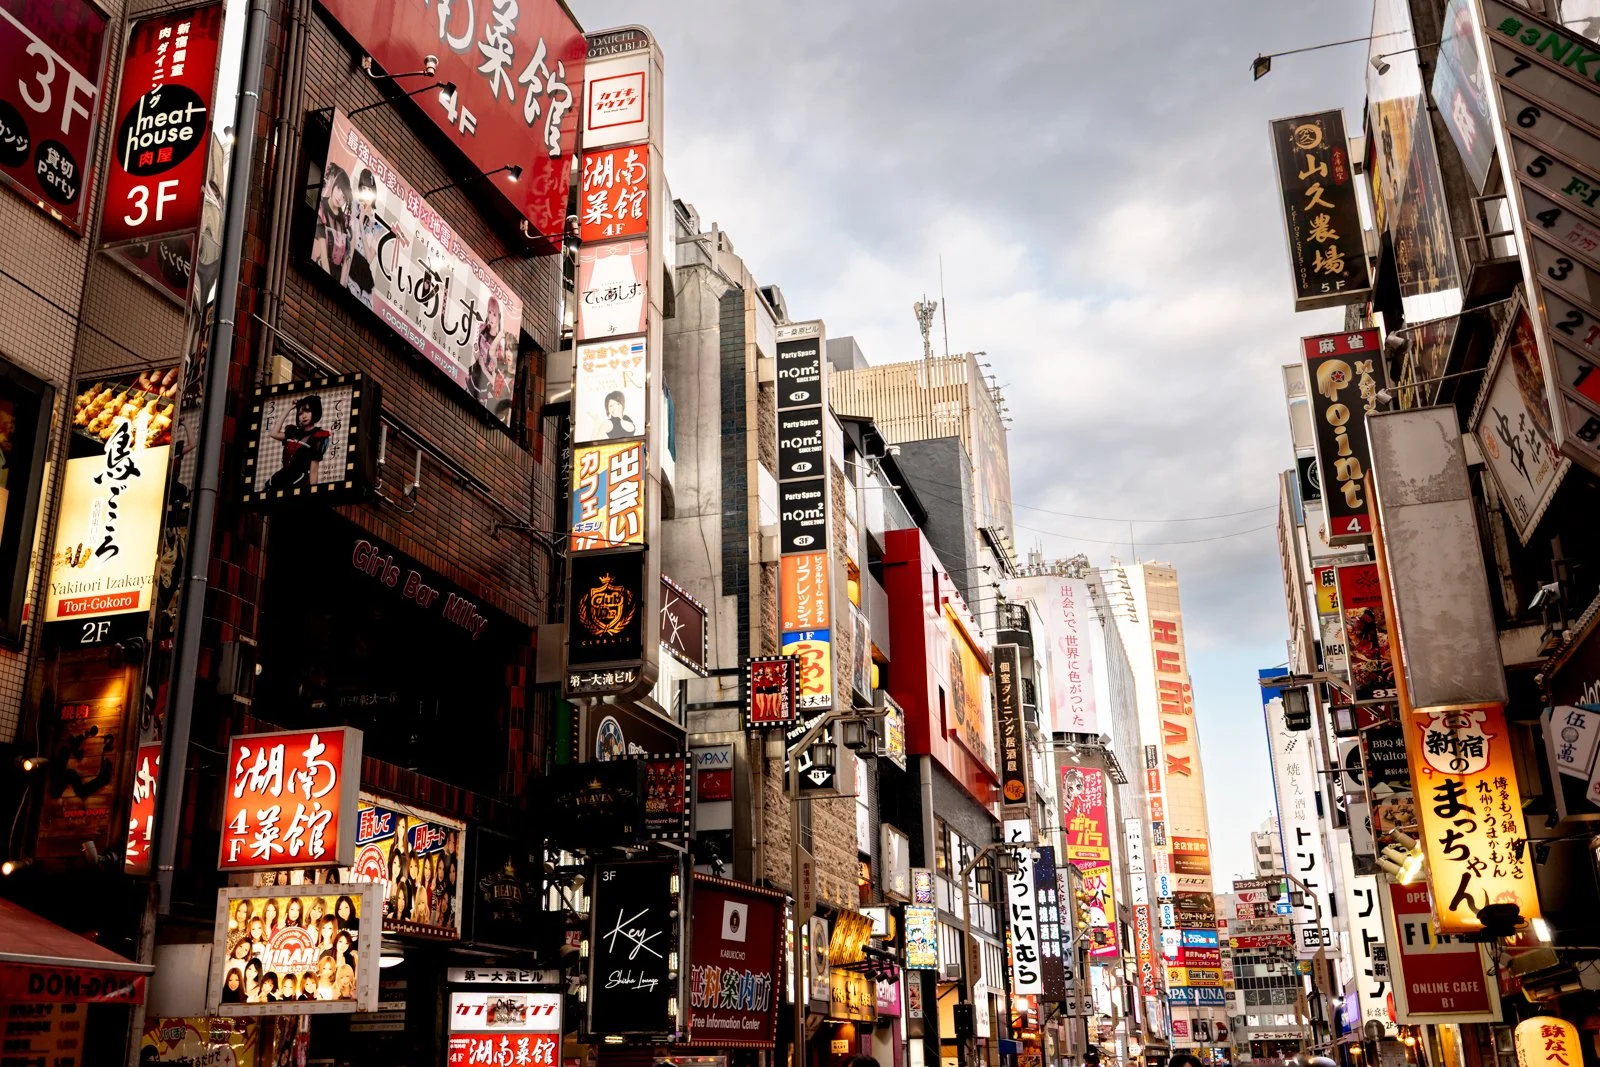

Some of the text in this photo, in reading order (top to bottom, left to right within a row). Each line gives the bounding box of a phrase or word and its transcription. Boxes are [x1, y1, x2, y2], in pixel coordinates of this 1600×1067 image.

[170, 22, 190, 77] 新宿個室
[1505, 56, 1532, 78] 7
[18, 42, 98, 136] 3F
[136, 95, 207, 136] meat
[437, 87, 478, 137] 4F
[1516, 106, 1541, 129] 6
[123, 126, 193, 172] house
[138, 148, 173, 166] 肉屋
[46, 147, 74, 178] 貸切
[583, 150, 647, 192] 湖南
[1526, 154, 1554, 178] 5
[37, 159, 76, 200] Party
[123, 179, 179, 226] 3F
[583, 187, 647, 225] 菜館
[1298, 153, 1345, 276] 山久農場
[602, 224, 626, 237] 4F
[1535, 208, 1563, 229] 4
[1547, 257, 1574, 282] 3
[1321, 280, 1346, 293] 5F
[386, 291, 463, 363] Dear My Sister
[1555, 310, 1585, 336] 2
[781, 349, 816, 359] Party Space
[1318, 335, 1365, 353] 麻雀
[794, 391, 805, 401] 5F
[783, 418, 819, 429] Party Space
[796, 463, 807, 471] 4F
[579, 450, 601, 520] カフェ
[608, 446, 640, 545] 出会い
[785, 490, 821, 501] Party Space
[574, 520, 603, 533] キラリ
[1346, 517, 1362, 533] 4
[798, 536, 809, 545] 3F
[50, 573, 155, 596] Yakitori Izakaya
[352, 539, 488, 641] Girls Bar Milky
[797, 557, 812, 628] リフレッシュ
[64, 595, 132, 614] Tori-Gokoro
[815, 599, 825, 623] ホステル
[80, 621, 111, 645] 2F
[784, 621, 794, 629] 2F
[798, 631, 815, 641] 1F
[1060, 584, 1085, 727] 出会いで、世界に色がついた
[570, 671, 636, 687] 第一大滝ビル
[780, 663, 790, 719] ワイン飲み放題
[61, 704, 90, 720] 焼肉
[999, 661, 1018, 772] 個室ダイニング居酒屋
[787, 723, 805, 741] Party
[1372, 739, 1393, 748] BBQ
[1425, 730, 1484, 758] 新宿
[234, 733, 337, 801] 湖南
[813, 771, 827, 780] B1
[1449, 757, 1470, 774] の
[1084, 774, 1092, 815] ガールズバー
[1492, 775, 1517, 835] 博多もつ鍋
[250, 801, 333, 861] 菜館
[359, 809, 392, 842] 話して
[1475, 779, 1507, 878] 九州のうまかもん
[413, 824, 446, 853] 即デート
[1432, 777, 1489, 915] まっちゃん
[602, 870, 617, 882] 3F
[602, 907, 663, 961] Key
[1012, 903, 1039, 985] にいむら
[719, 948, 746, 961] KABUKICHO
[464, 970, 544, 983] 第一大滝ビル
[691, 964, 772, 1012] 無料案内所
[1412, 981, 1479, 997] ONLINE CAFE
[1442, 996, 1455, 1008] B1
[691, 1013, 760, 1030] Free Information Center
[469, 1035, 556, 1067] 湖南菜館
[1539, 1023, 1570, 1067] 鉄なべ
[450, 1053, 465, 1063] 4F
